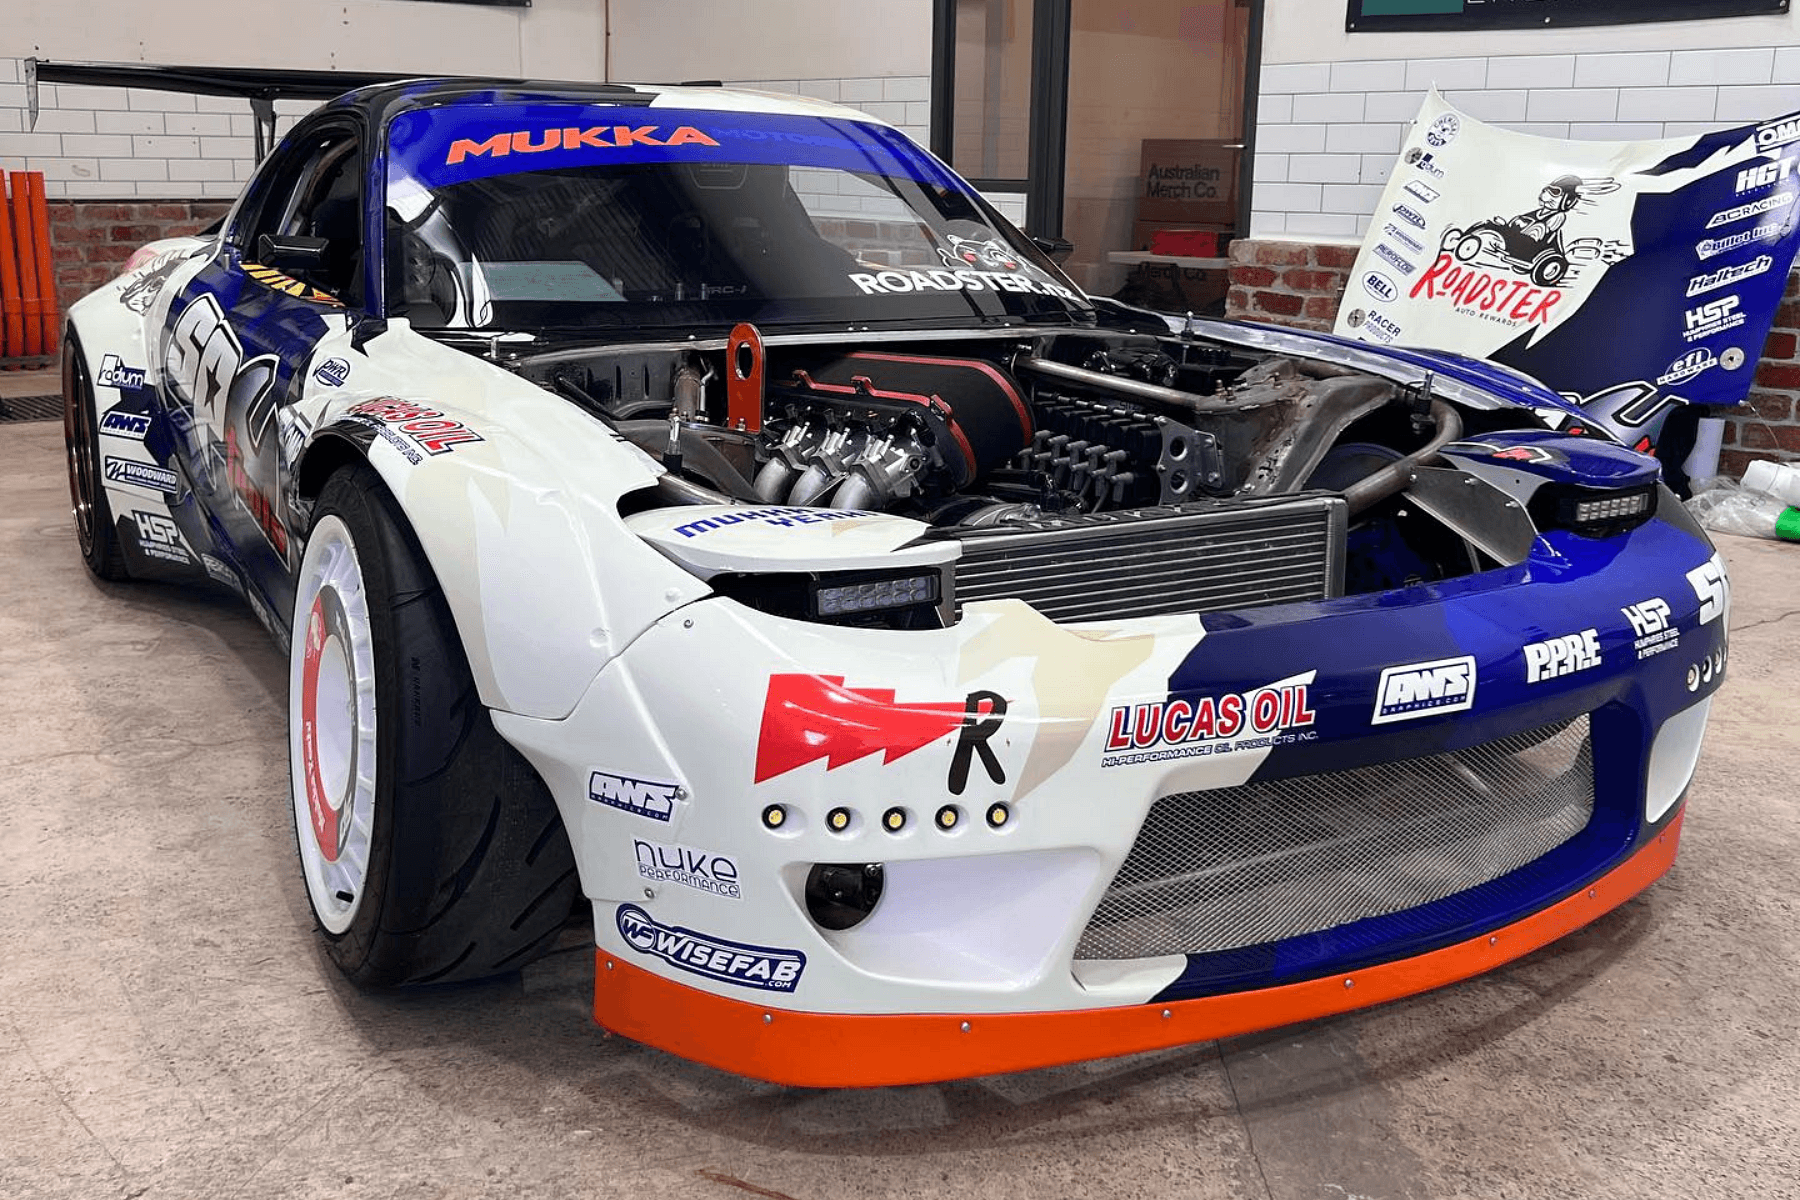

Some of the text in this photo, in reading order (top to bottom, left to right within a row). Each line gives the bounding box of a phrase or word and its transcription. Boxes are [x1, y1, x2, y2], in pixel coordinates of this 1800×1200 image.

[446, 126, 720, 165] MUKKA
[1147, 181, 1191, 198] Merch
[1149, 164, 1220, 181] Australian
[1367, 274, 1394, 299] BELL
[1409, 254, 1561, 324] ROADSTER
[1687, 255, 1772, 297] Haltech
[1368, 310, 1401, 337] RACER
[1685, 294, 1740, 330] HSP
[125, 462, 177, 485] WOODWARD
[134, 511, 179, 546] HSP
[1620, 596, 1672, 637] HSP
[1384, 663, 1470, 707] AWS
[1105, 685, 1316, 752] LUCAS OIL
[948, 690, 1007, 795] R
[1102, 744, 1213, 767] HI-PERFORMANCE
[1233, 733, 1296, 752] PRODUCTS
[591, 773, 678, 814] AWS
[634, 839, 737, 883] nuke
[656, 931, 801, 983] WISEFAB
